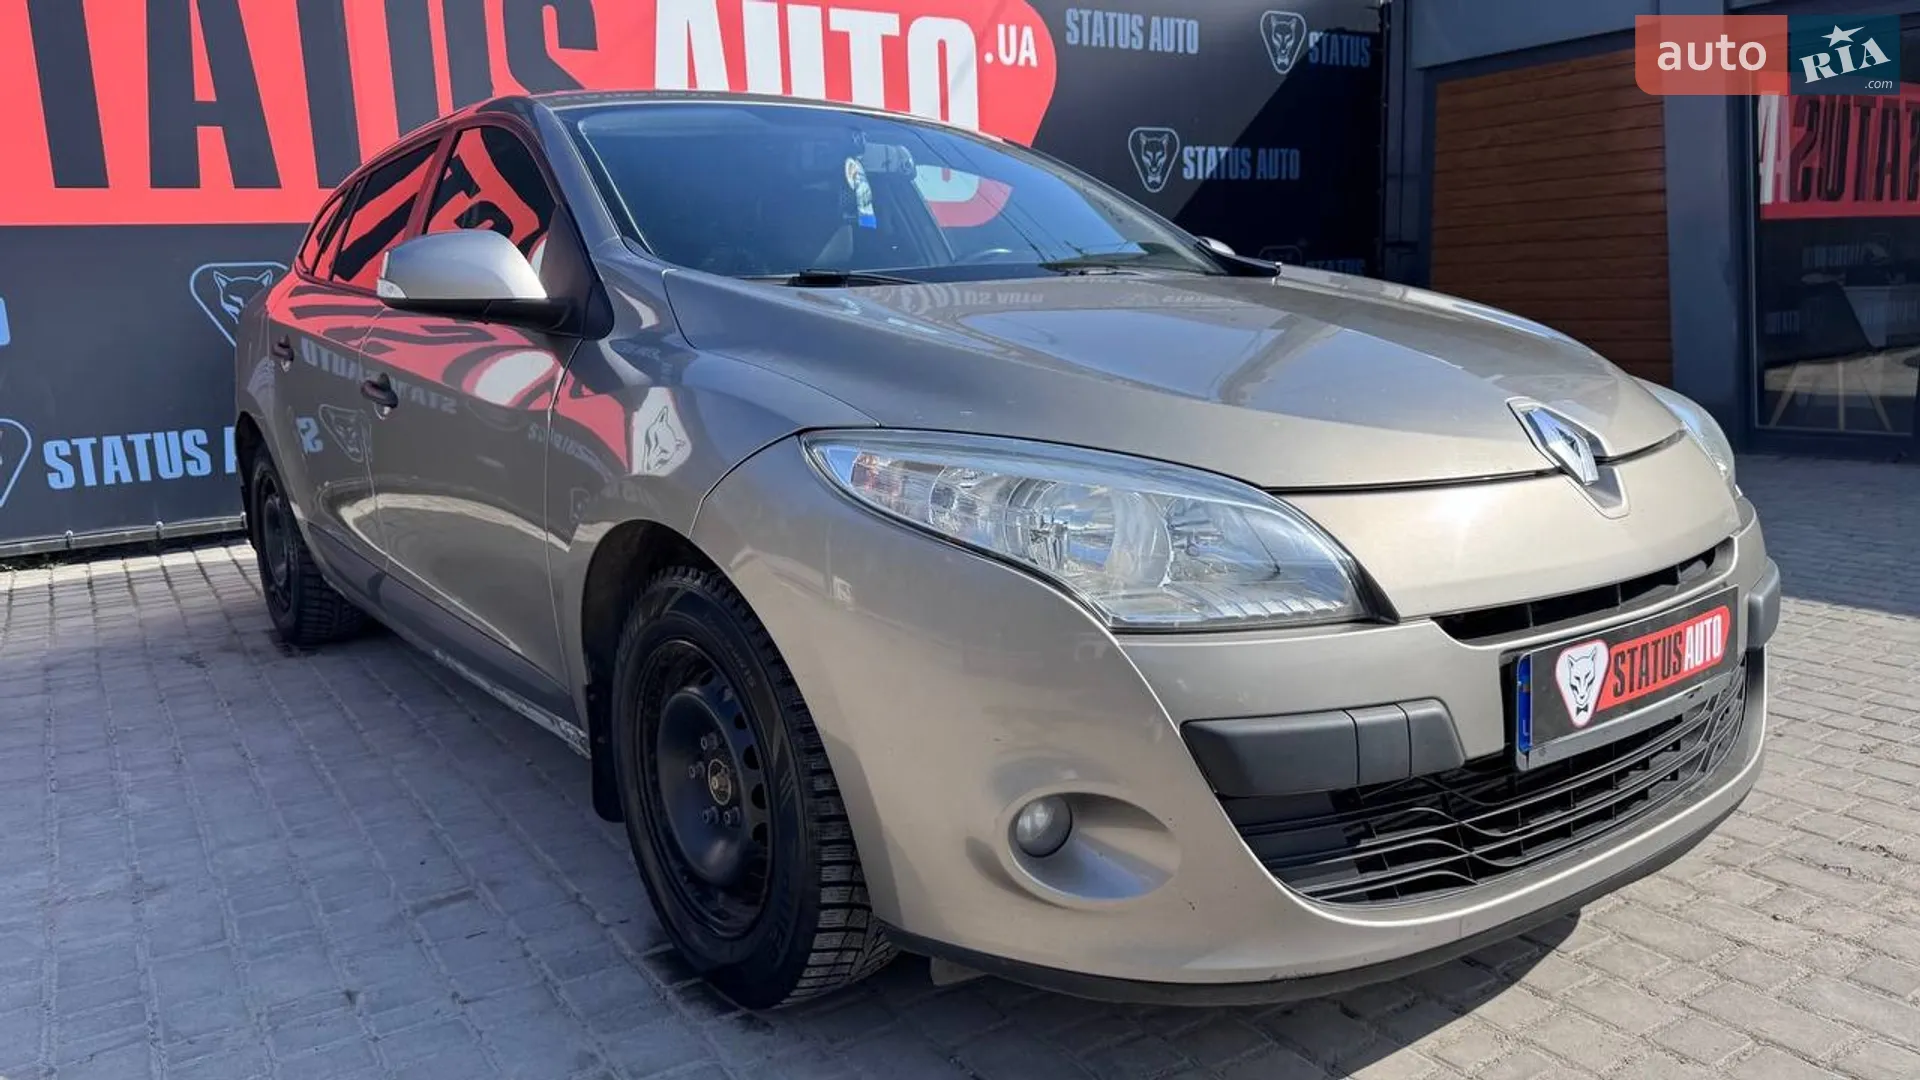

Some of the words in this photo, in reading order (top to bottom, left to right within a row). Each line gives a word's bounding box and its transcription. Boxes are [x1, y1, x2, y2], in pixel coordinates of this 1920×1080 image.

[1065, 8, 1144, 50] STATUS
[1149, 17, 1199, 54] AUTO
[1308, 31, 1371, 67] STATUS
[1183, 146, 1251, 180] STATUS
[1256, 148, 1301, 180] AUTO
[43, 429, 212, 490] STATUS
[1612, 631, 1683, 698] STATUS
[1684, 614, 1722, 672] AUTO
